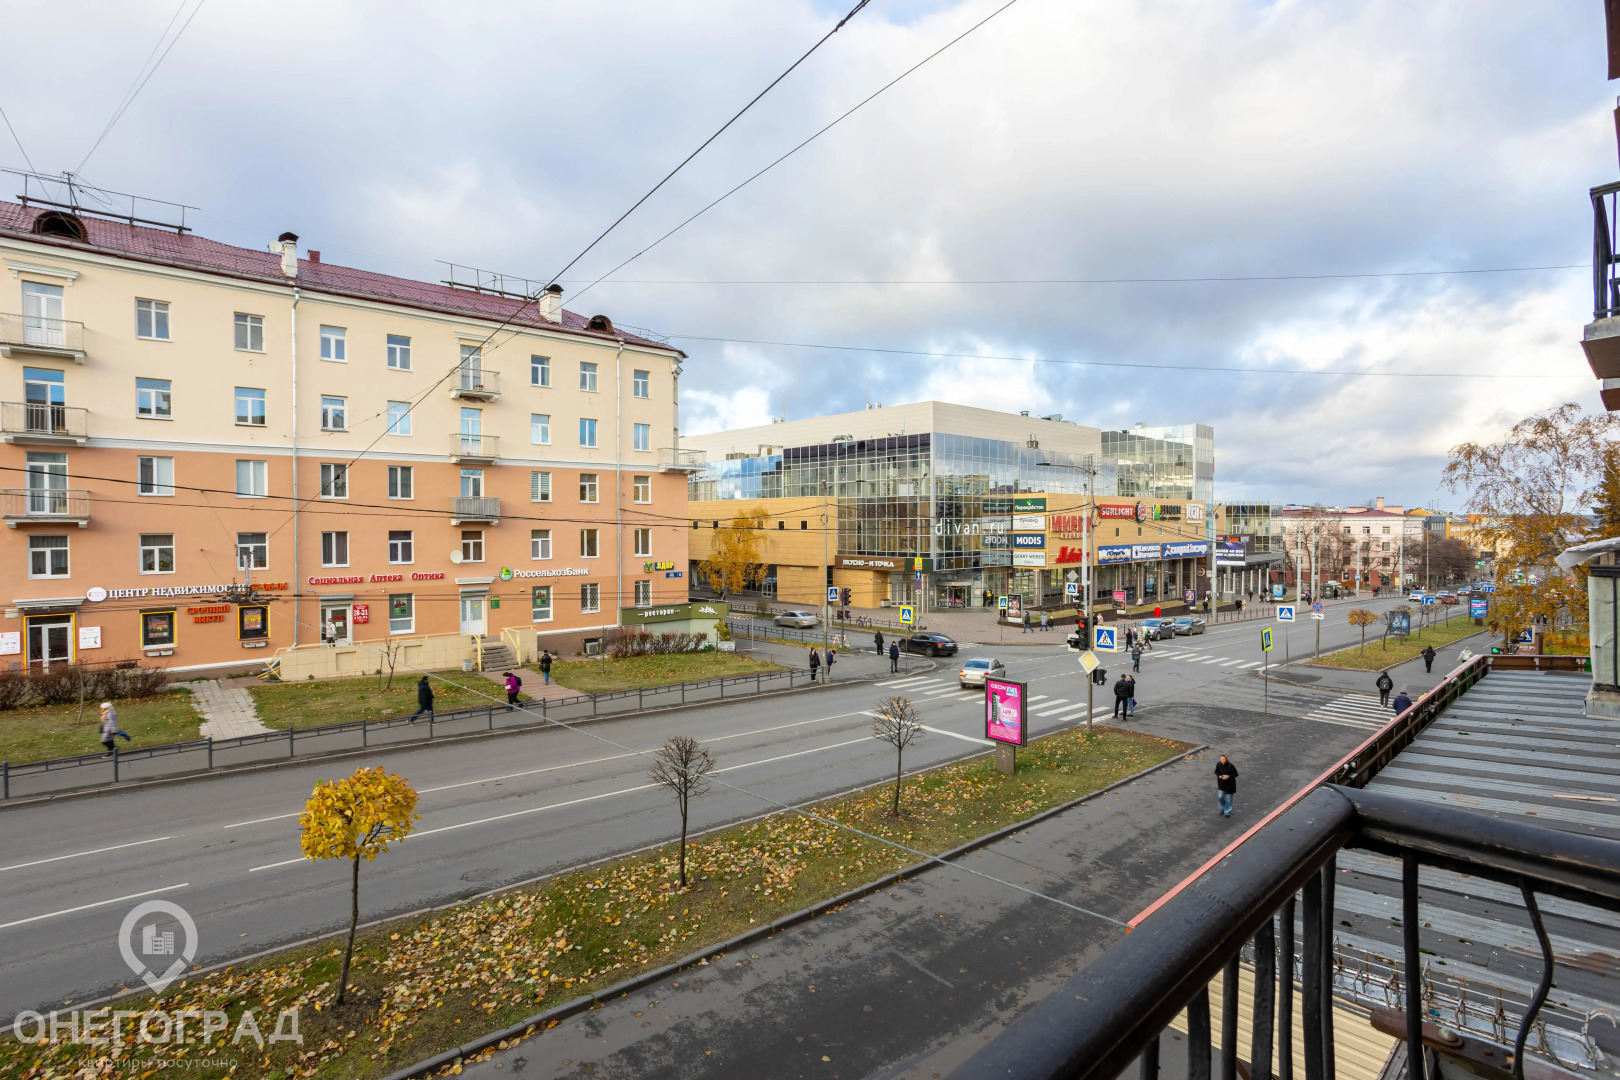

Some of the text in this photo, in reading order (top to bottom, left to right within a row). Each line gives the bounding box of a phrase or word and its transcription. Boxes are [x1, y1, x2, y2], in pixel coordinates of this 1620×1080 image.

[1101, 508, 1133, 516] SUNLIGHT
[935, 518, 1004, 535] divan.ru
[1016, 537, 1042, 545] MODIS
[656, 561, 674, 571] ЛДПР
[513, 567, 589, 578] РоссельхозБанк
[308, 571, 444, 586] Социальная Аптека Оптика
[108, 588, 148, 600] ЦЕНТР
[186, 604, 230, 615] СРОЧНЫЙ
[644, 608, 675, 618] ресторан
[193, 614, 224, 624] ВЫКУП
